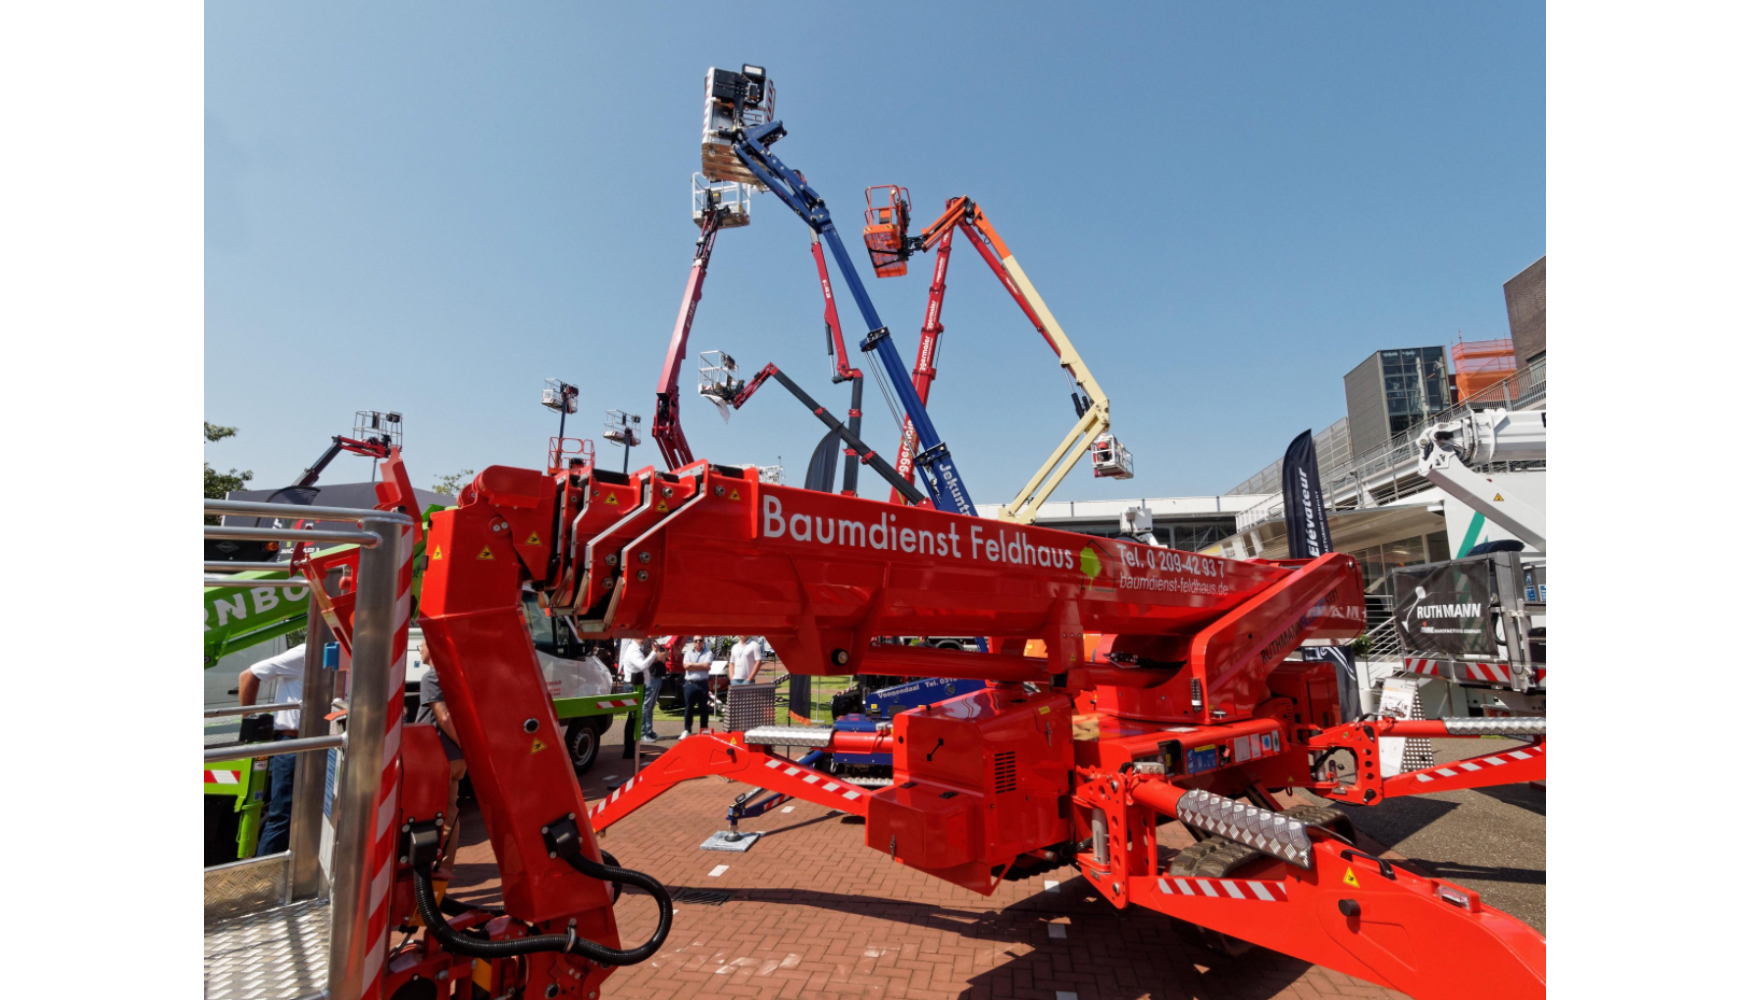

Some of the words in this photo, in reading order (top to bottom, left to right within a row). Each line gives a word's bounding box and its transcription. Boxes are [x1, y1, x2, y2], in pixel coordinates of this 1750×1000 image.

[1298, 467, 1320, 557] Elévateur
[763, 494, 962, 559] Baumdienst
[971, 523, 1075, 571] Feldhaus
[1117, 544, 1144, 569] Tel.
[1146, 549, 1155, 570] 0
[1158, 550, 1201, 575] 209-42
[1202, 558, 1217, 577] 93
[1218, 560, 1224, 578] 7
[1119, 572, 1229, 596] baumdienst-feldhaus.de
[1416, 603, 1481, 619] RUTHMANN
[878, 685, 920, 698] Veenendaal
